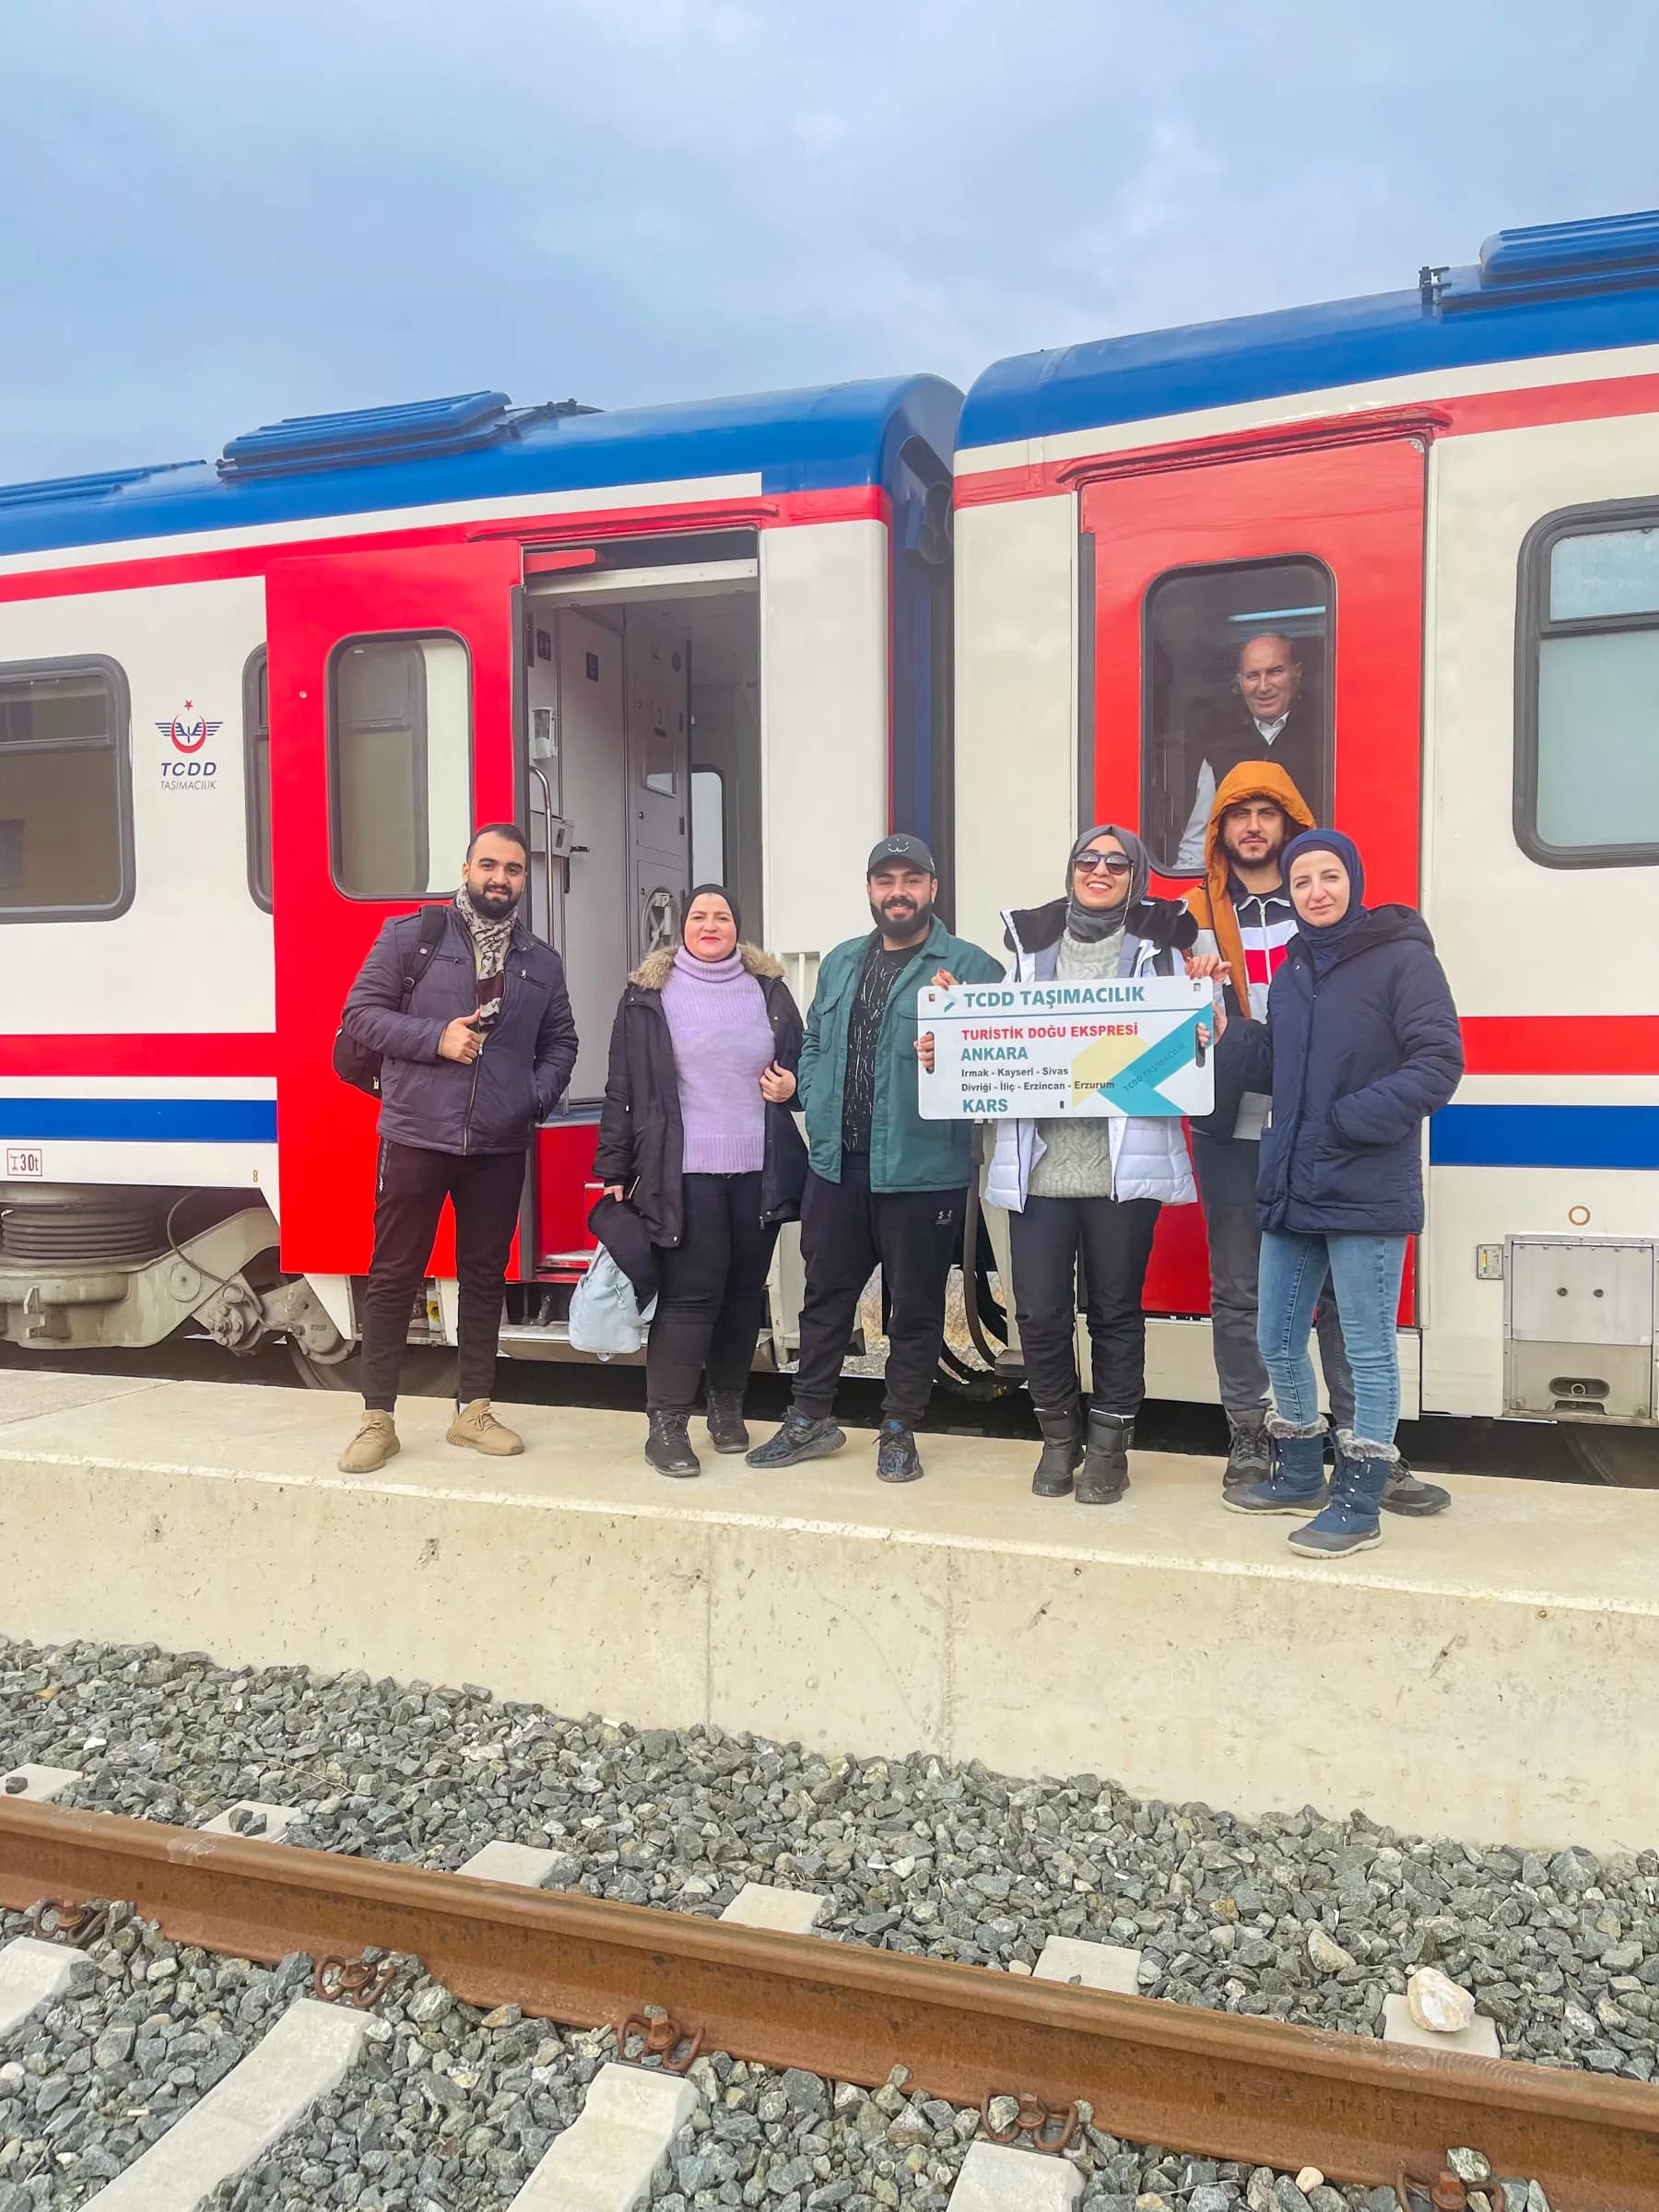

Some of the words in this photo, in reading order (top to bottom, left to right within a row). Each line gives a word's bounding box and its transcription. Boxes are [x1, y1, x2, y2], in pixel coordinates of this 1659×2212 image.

[160, 762, 217, 776] TCDD
[964, 992, 1015, 1007] TCDD
[1019, 986, 1145, 1009] TAŞIMACILIK
[961, 1026, 1024, 1041] TURİSTİK
[1028, 1025, 1066, 1039] DOĞU
[1071, 1021, 1138, 1037] EKSPRESİ
[961, 1047, 1029, 1061] ANKARA
[961, 1069, 989, 1077] Irmak
[997, 1067, 1034, 1077] Kayseri
[1042, 1067, 1068, 1076] Sivas
[961, 1083, 992, 1093] Divriği
[1000, 1081, 1016, 1092] İliç
[1023, 1082, 1065, 1090] Erzincan
[1074, 1081, 1115, 1089] Erzurum
[962, 1099, 1008, 1112] KARS
